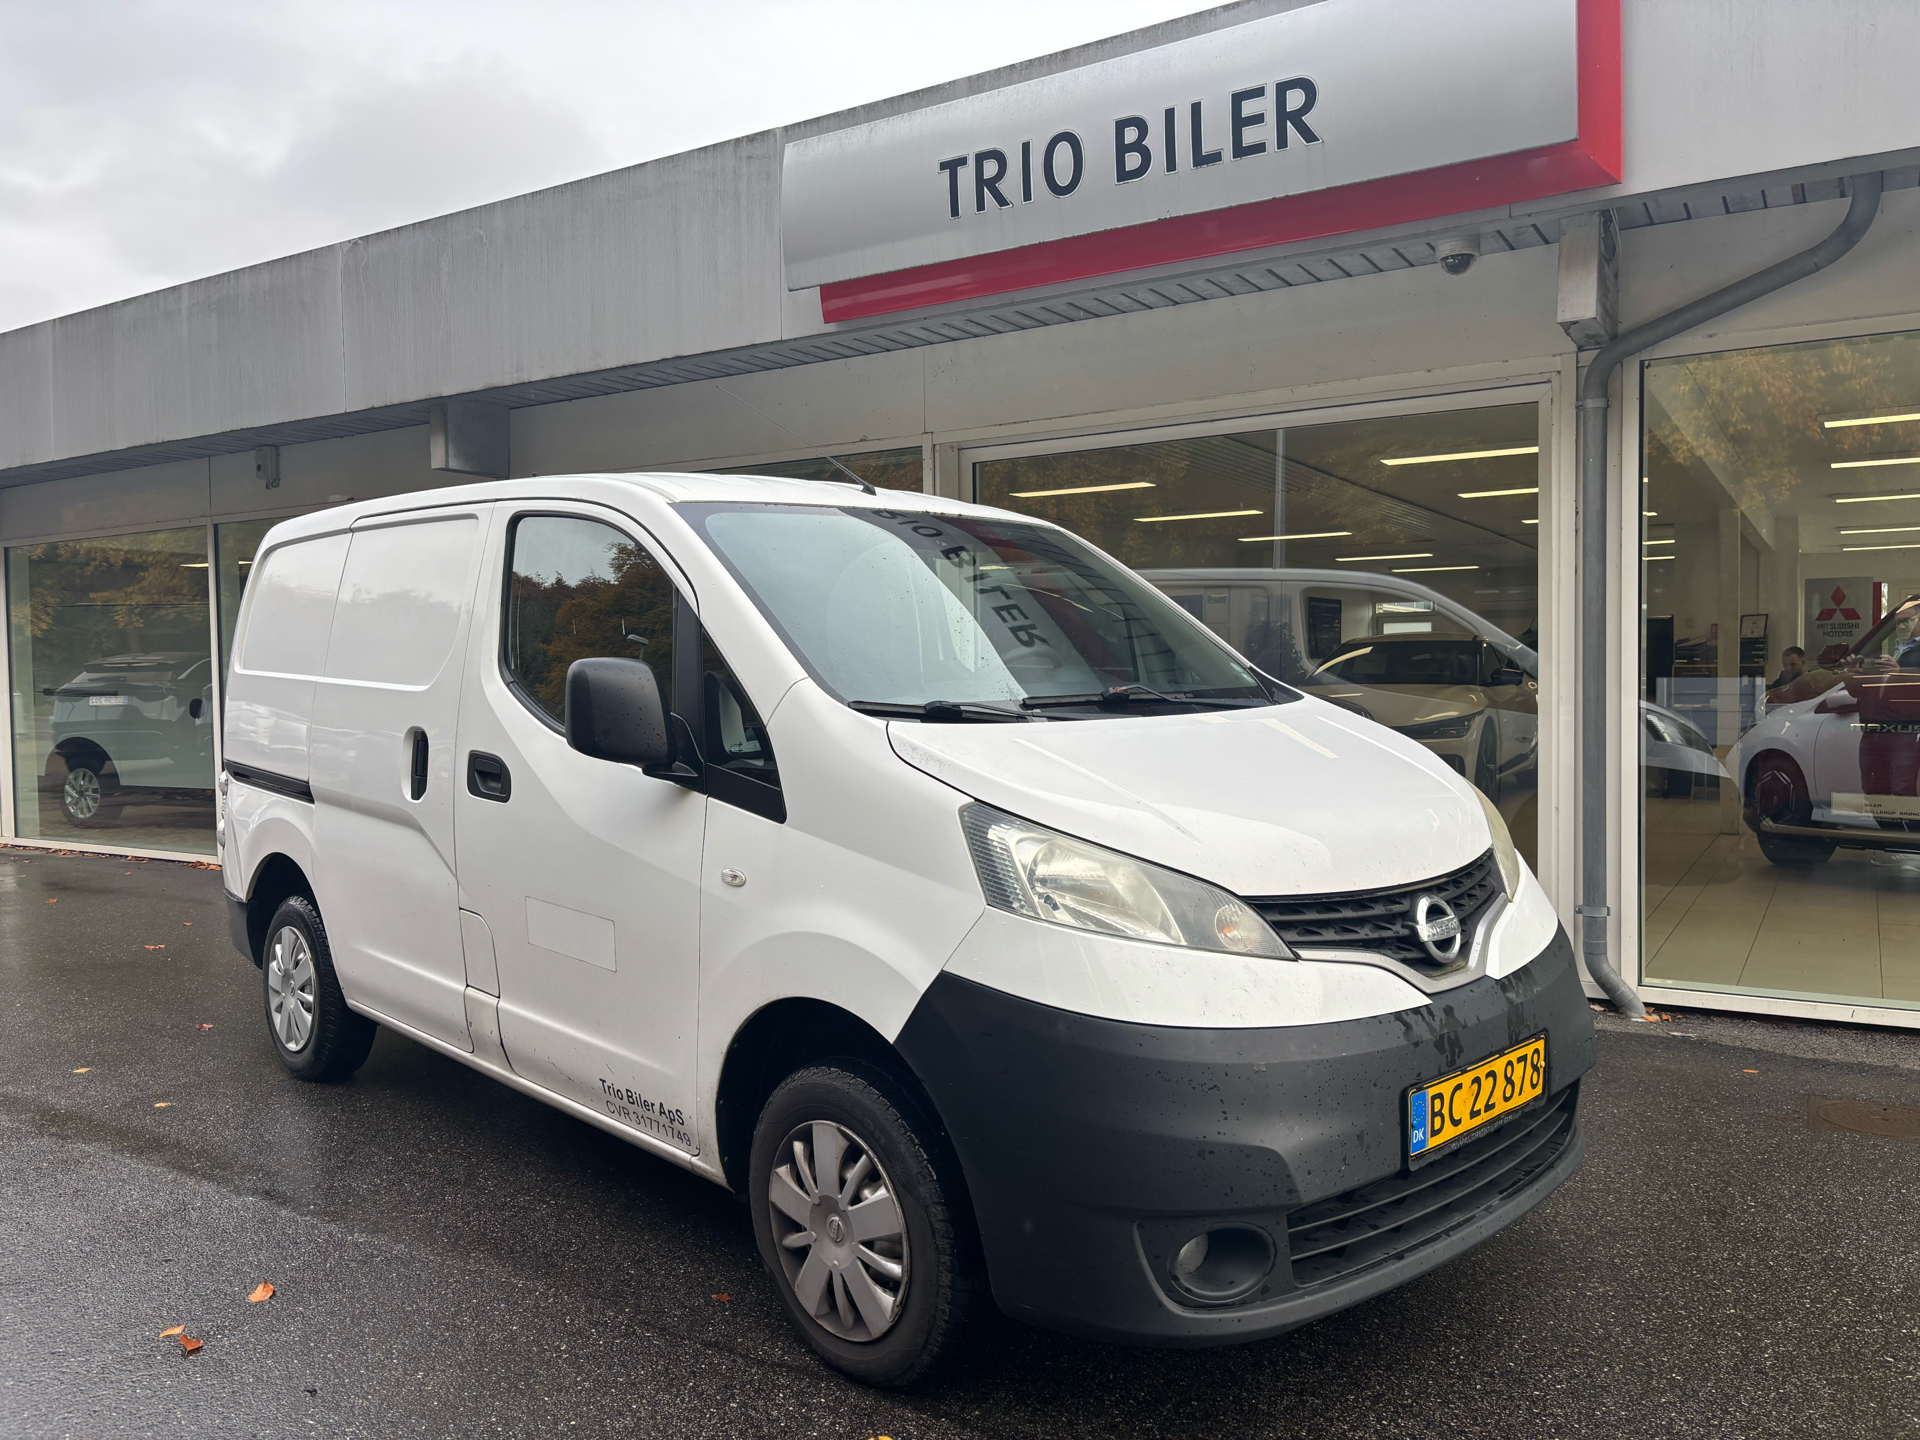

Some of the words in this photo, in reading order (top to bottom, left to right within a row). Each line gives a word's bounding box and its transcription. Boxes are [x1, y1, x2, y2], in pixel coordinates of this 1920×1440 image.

[938, 127, 1086, 220] TRIO
[1112, 74, 1325, 186] BILER
[1816, 622, 1860, 630] MITSUBISHI
[1822, 630, 1854, 638] MOTORS
[599, 1078, 624, 1101] Trio
[625, 1088, 655, 1114] Biler
[659, 1102, 685, 1126] ApS
[1430, 1082, 1463, 1139] BC
[1469, 1069, 1498, 1121] 22
[1502, 1047, 1541, 1103] 878
[606, 1100, 632, 1122] CVR
[633, 1111, 692, 1147] 31771749
[1413, 1128, 1425, 1144] DK
